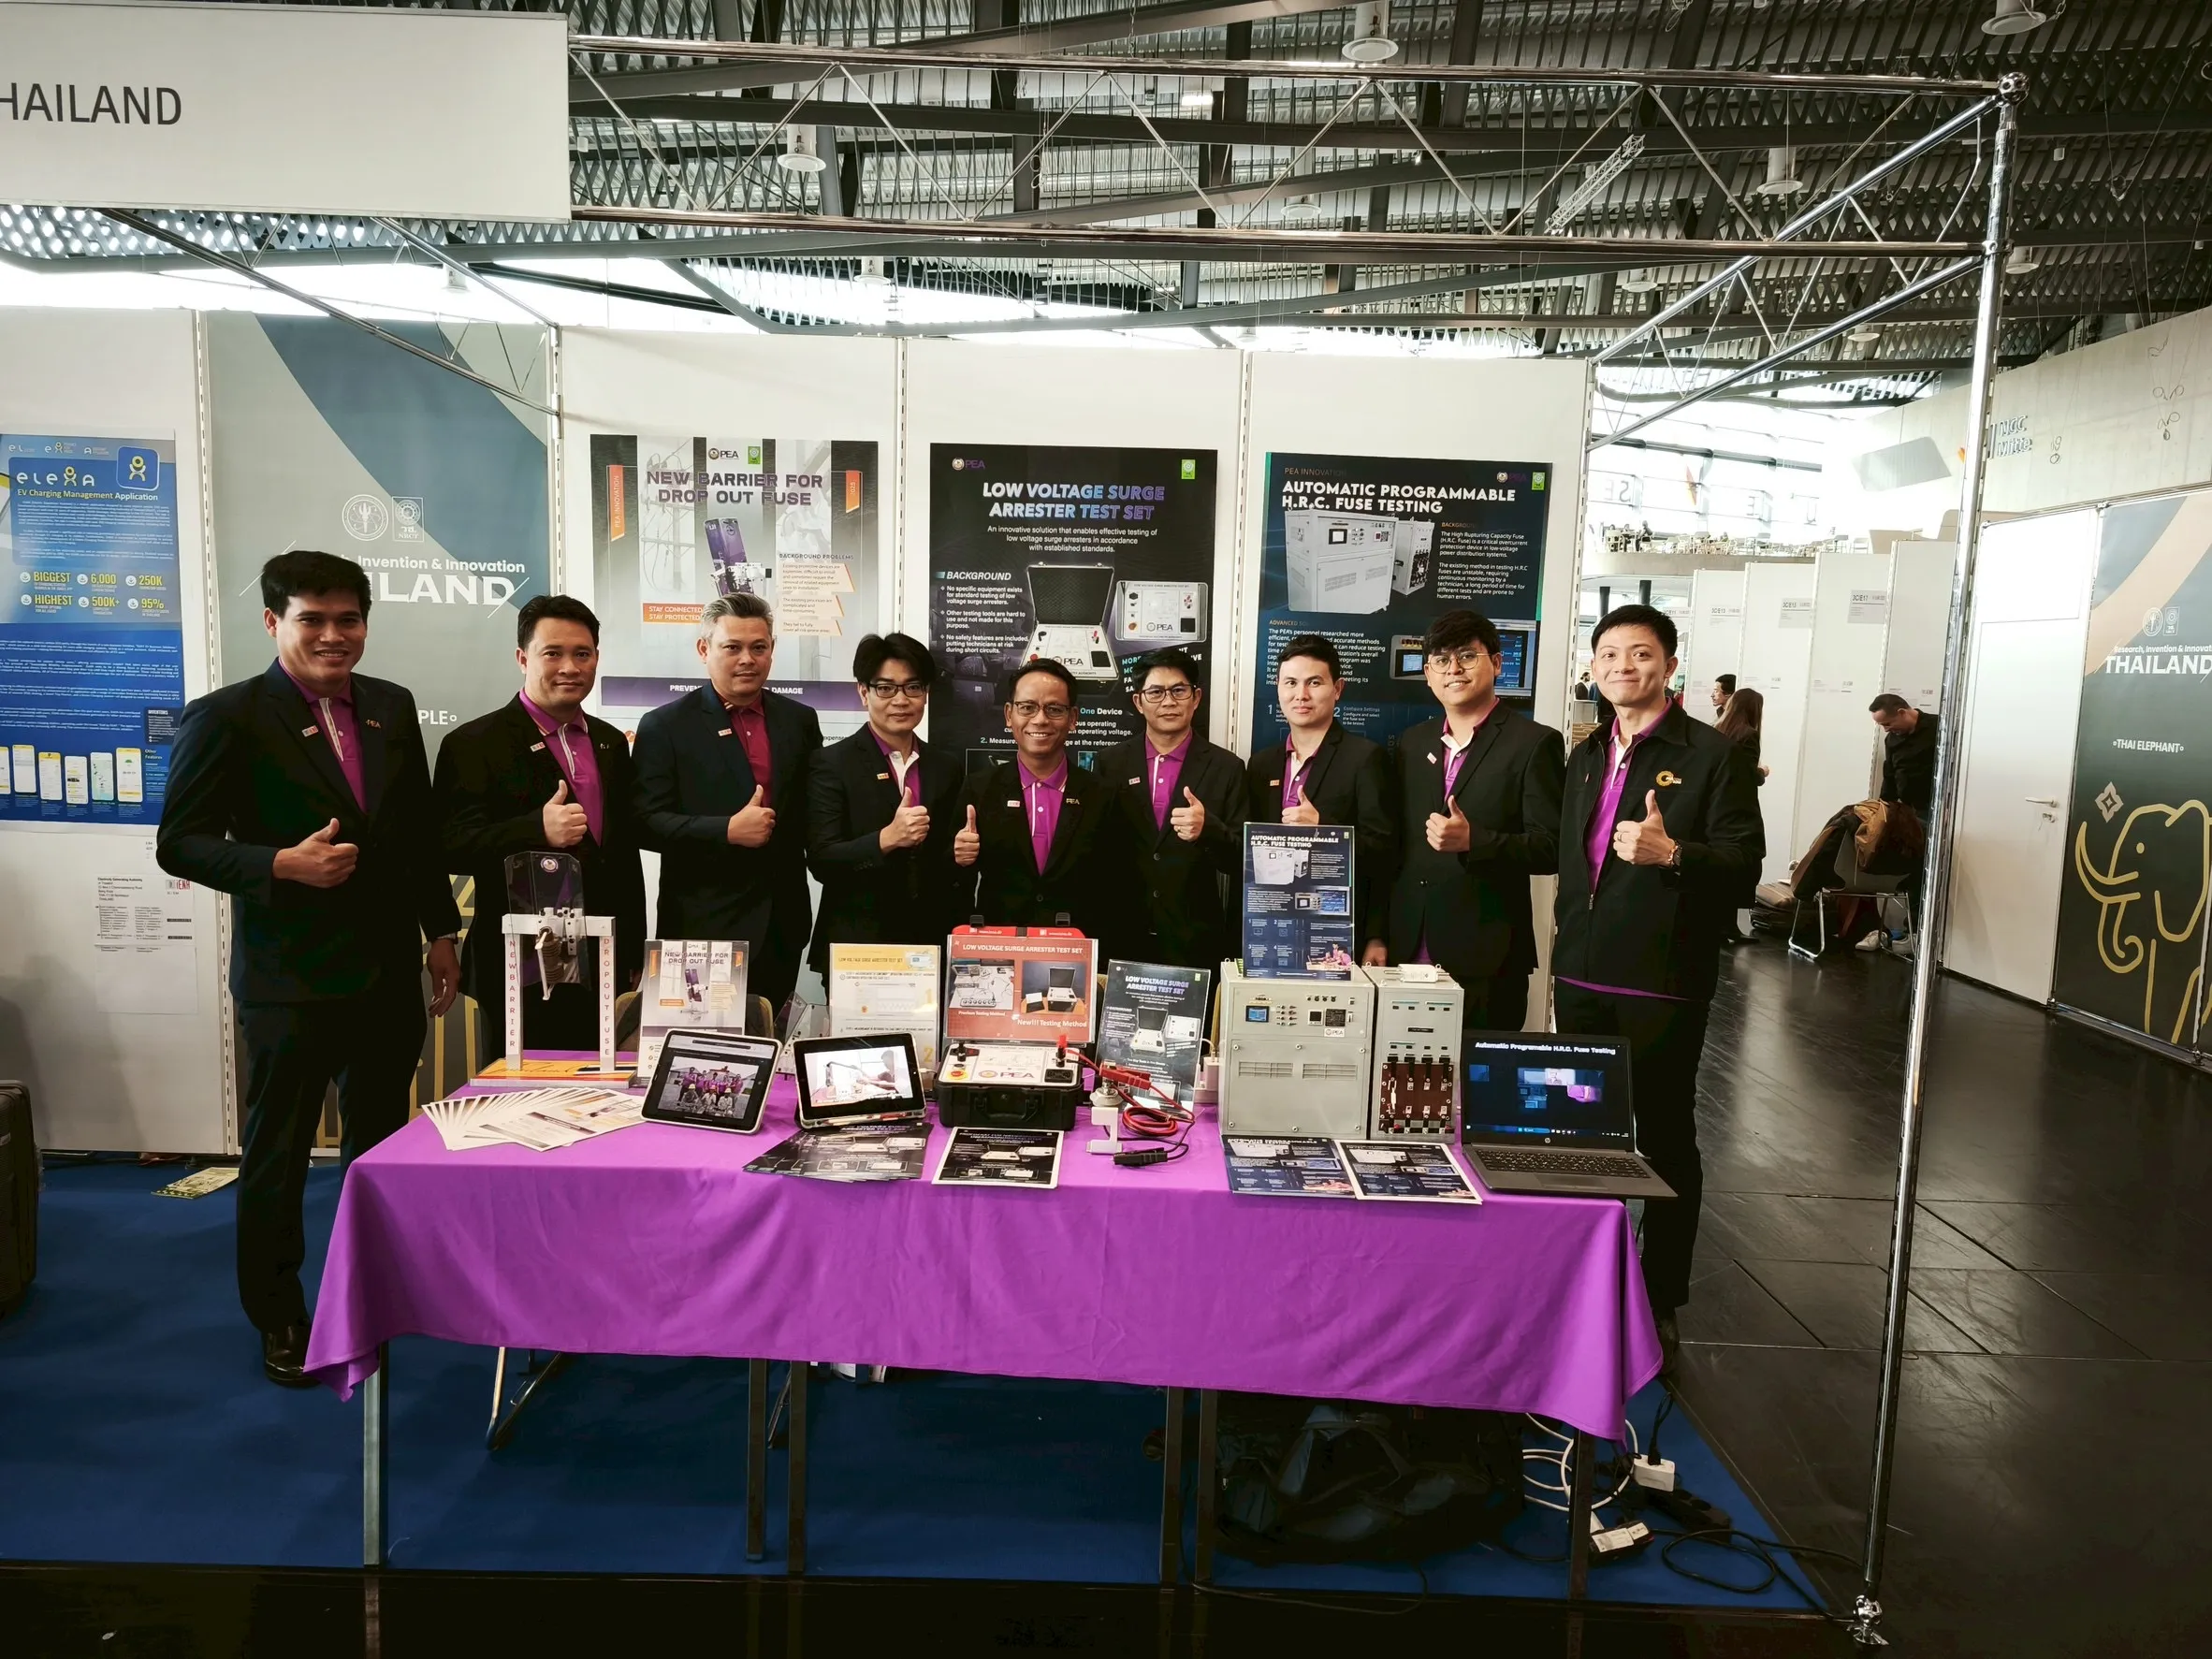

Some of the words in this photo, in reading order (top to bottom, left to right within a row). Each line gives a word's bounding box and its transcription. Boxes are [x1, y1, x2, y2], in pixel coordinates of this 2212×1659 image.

[2000, 415, 2028, 436] NCC
[1997, 438, 2032, 457] Mitte
[648, 472, 691, 485] NEW
[698, 473, 778, 487] BARRIER
[786, 474, 822, 488] FOR
[30, 490, 62, 499] Charging
[64, 491, 113, 500] Management
[115, 492, 158, 501] Application
[659, 489, 708, 502] DROP
[716, 490, 753, 504] OUT
[762, 492, 811, 505] FUSE
[983, 482, 1024, 498] LOW
[1026, 483, 1103, 499] VOLTAGE
[1108, 485, 1165, 501] SURGE
[1283, 481, 1375, 496] AUTOMATIC
[1381, 485, 1516, 502] PROGRAMMABLE
[989, 502, 1075, 518] ARRESTER
[1080, 504, 1120, 518] TEST
[1123, 505, 1155, 520] SET
[1282, 495, 1330, 509] H.R.C.
[1336, 498, 1373, 510] FUSE
[1378, 499, 1443, 513] TESTING
[1128, 529, 1149, 537] testing
[357, 555, 428, 570] Invention
[431, 559, 442, 570] &
[445, 560, 525, 573] Innovation
[34, 572, 70, 583] BIGGEST
[139, 575, 162, 586] 250K
[947, 572, 1011, 580] BACKGROUND
[35, 594, 72, 605] HIGHEST
[93, 597, 120, 607] 500K+
[142, 599, 164, 609] 95%
[2104, 655, 2212, 675] THAILAND
[1268, 705, 1273, 714] 1
[1333, 706, 1340, 717] 2
[2117, 738, 2136, 749] THAI
[2137, 740, 2180, 753] ELEPHANT
[1127, 983, 1157, 992] ARRESTER
[1510, 1043, 1551, 1052] Programable
[1592, 1047, 1616, 1055] Testing
